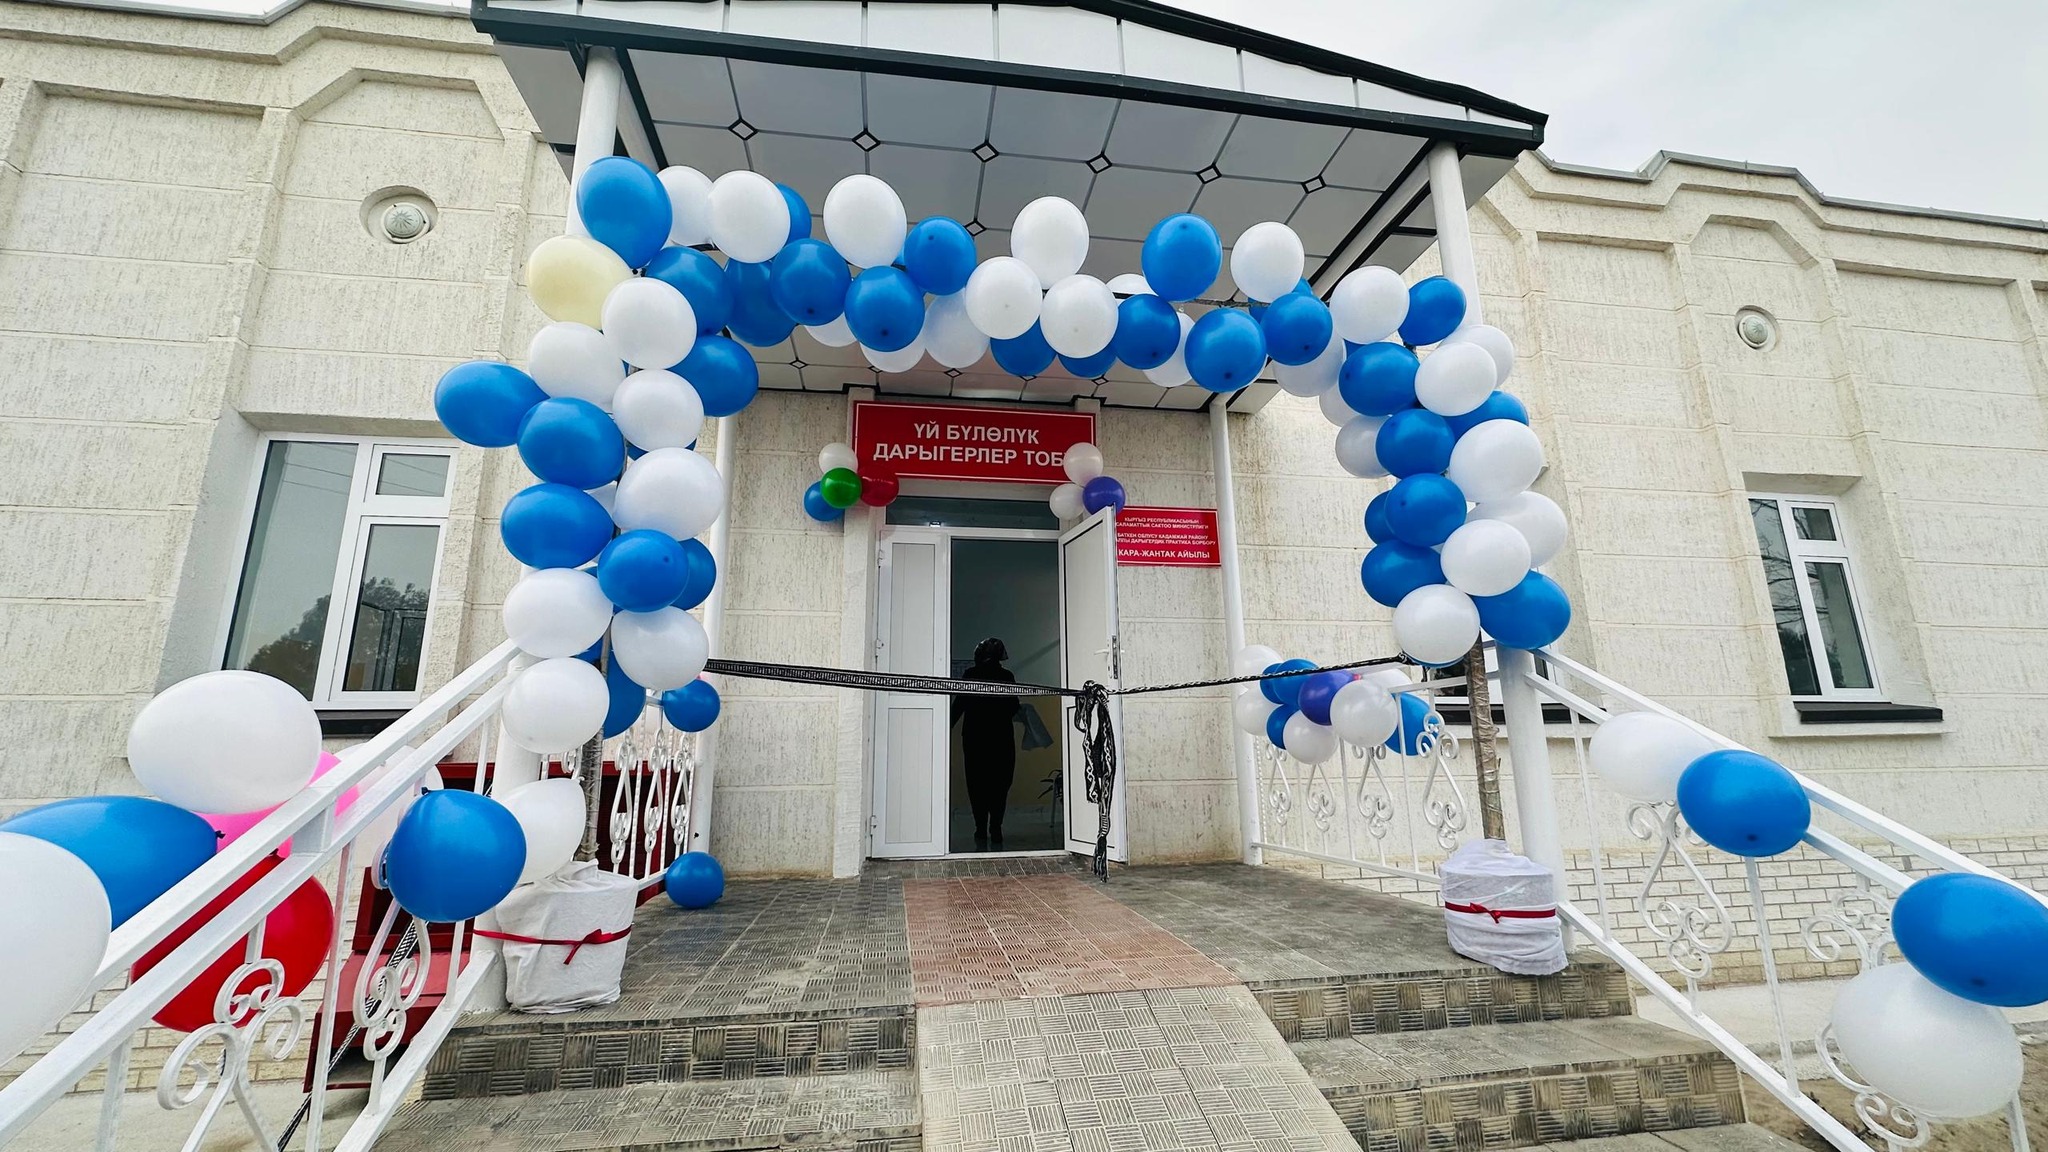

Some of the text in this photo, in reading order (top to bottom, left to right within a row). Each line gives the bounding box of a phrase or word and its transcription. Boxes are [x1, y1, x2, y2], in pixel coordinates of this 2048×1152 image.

[914, 420, 1040, 445] ҮЙ БҮЛӨЛҮК
[873, 443, 1067, 467] ДАРЫГЕРЛЕР ТОБ
[1118, 549, 1210, 559] КАРА-ЖАНТАК АЙЫЛЫ
